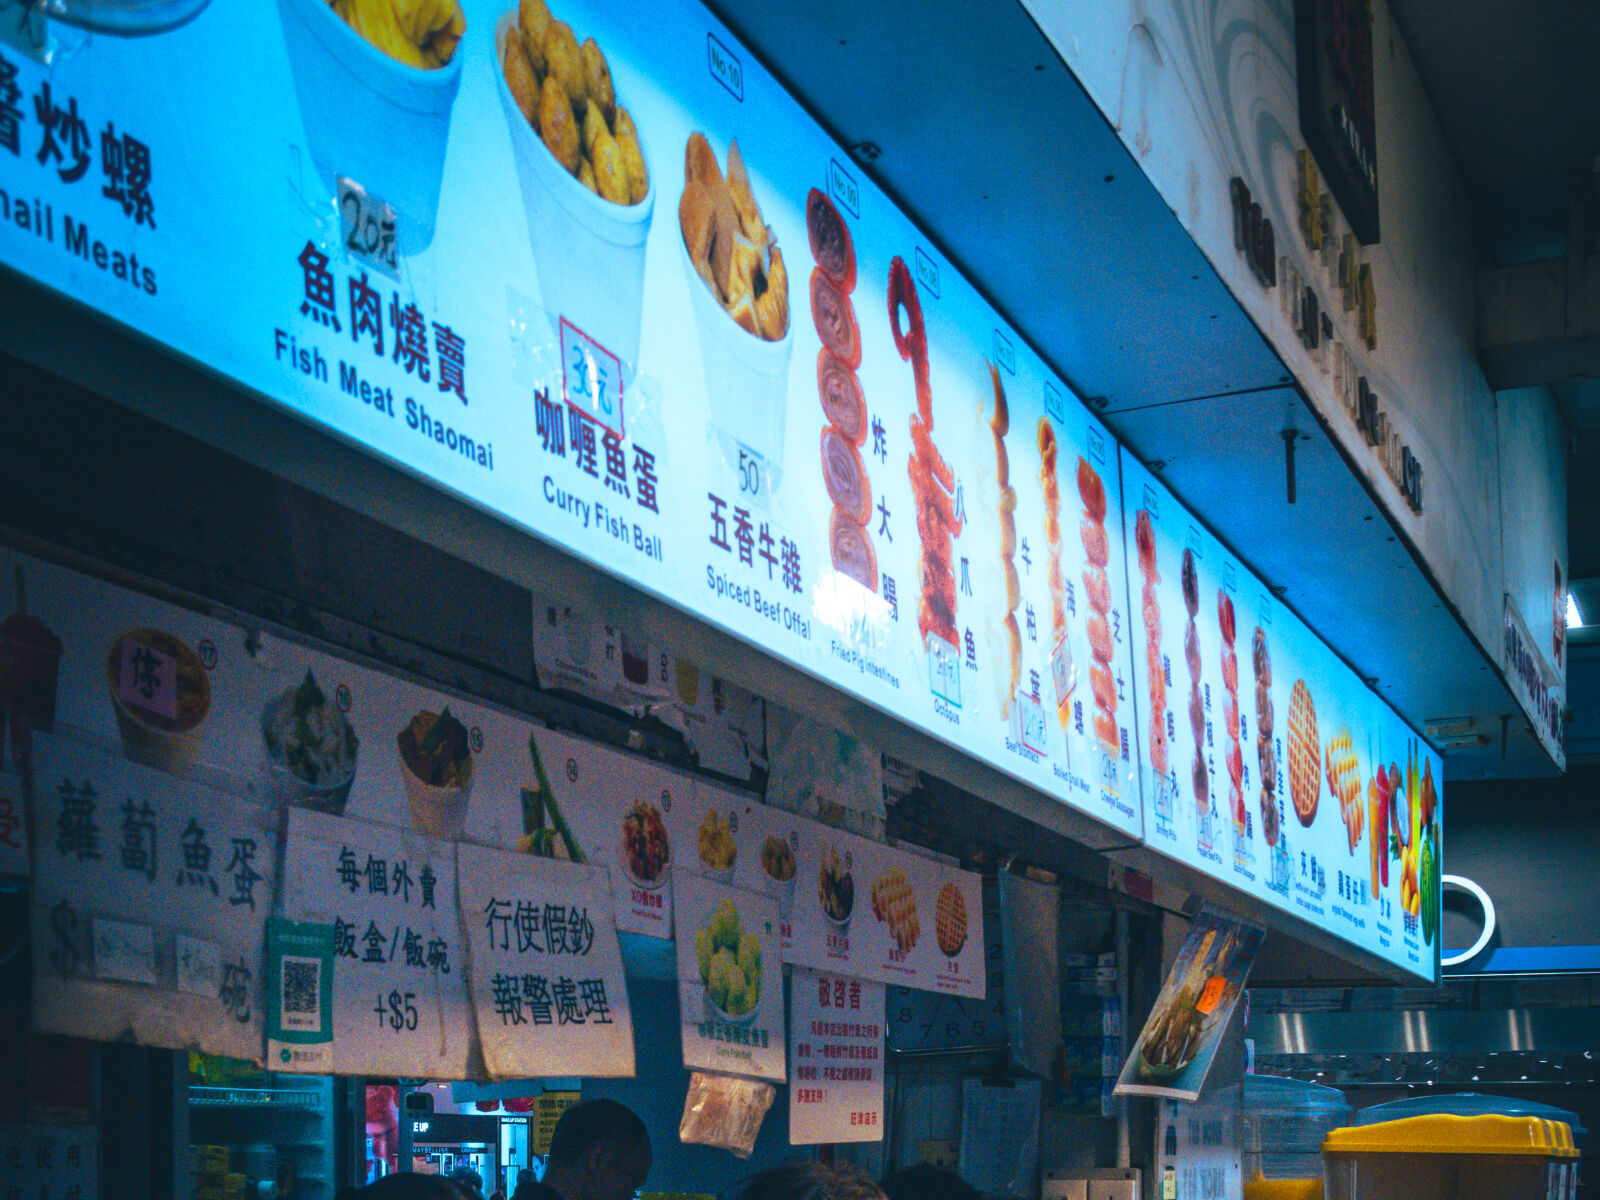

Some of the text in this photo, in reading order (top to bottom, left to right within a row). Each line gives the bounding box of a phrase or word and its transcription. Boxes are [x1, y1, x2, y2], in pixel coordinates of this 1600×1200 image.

[711, 46, 740, 89] No 10
[64, 214, 158, 297] Meats
[339, 191, 399, 270] 20元
[297, 240, 469, 406] 魚肉燒賣
[274, 328, 494, 471] Fish Meat Shaomai
[534, 386, 659, 515] 咖喱魚蛋
[738, 449, 759, 495] 50
[543, 475, 663, 562] Curry Fish Ball
[707, 492, 803, 594] 五香牛雜
[872, 415, 898, 622] 炸大腸
[706, 565, 811, 641] Spiced Beef Offal
[956, 479, 978, 672] 八爪魚
[830, 639, 851, 666] Fried
[851, 651, 865, 675] Pig
[56, 777, 263, 913] 蘿蔔魚蛋
[336, 845, 438, 910] 每個外賣
[334, 915, 450, 974] 飯盒/飯碗
[484, 896, 595, 956] 行使假鈔
[374, 990, 419, 1032] +$5
[491, 972, 614, 1027] 報警處理
[900, 1007, 912, 1023] 8
[946, 1022, 960, 1038] 6
[972, 1020, 985, 1036] 5
